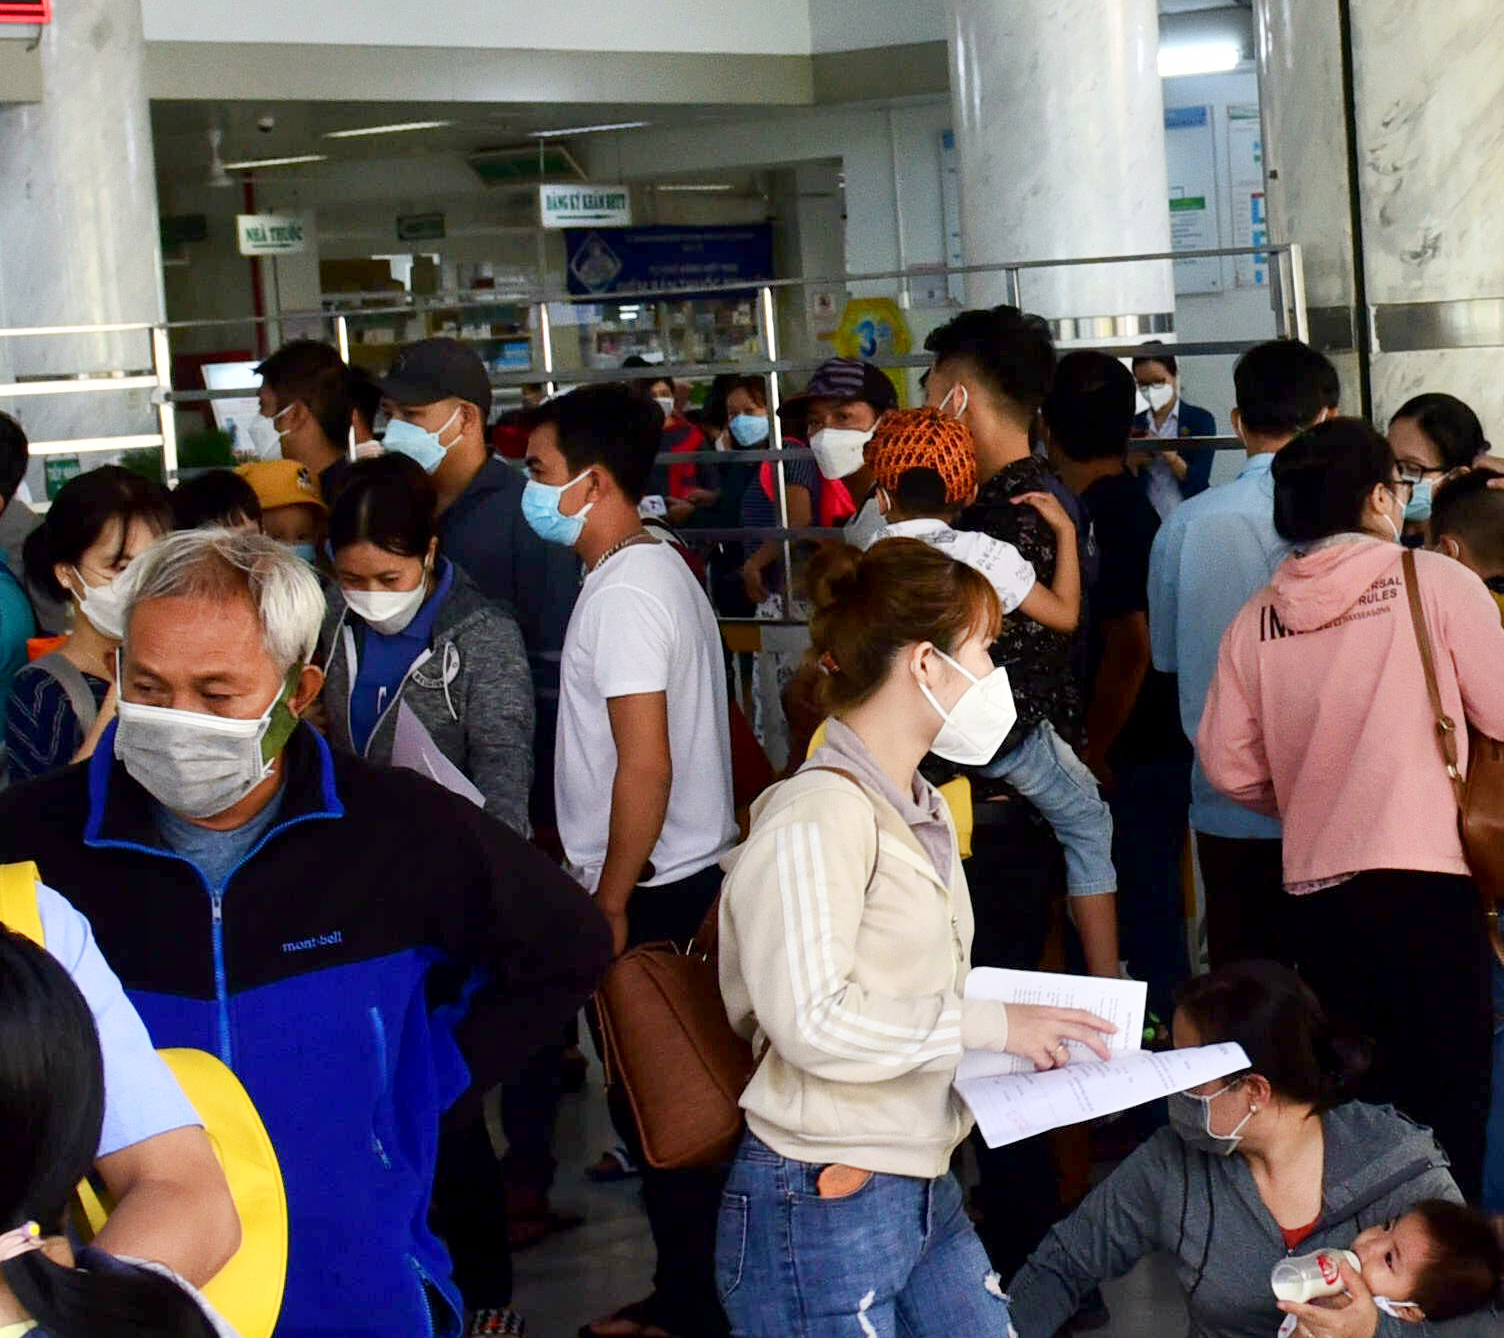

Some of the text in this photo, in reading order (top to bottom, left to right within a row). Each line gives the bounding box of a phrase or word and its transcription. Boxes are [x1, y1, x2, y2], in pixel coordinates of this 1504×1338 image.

[245, 221, 303, 242] NHÀ THUỐC
[1358, 588, 1398, 606] RULES
